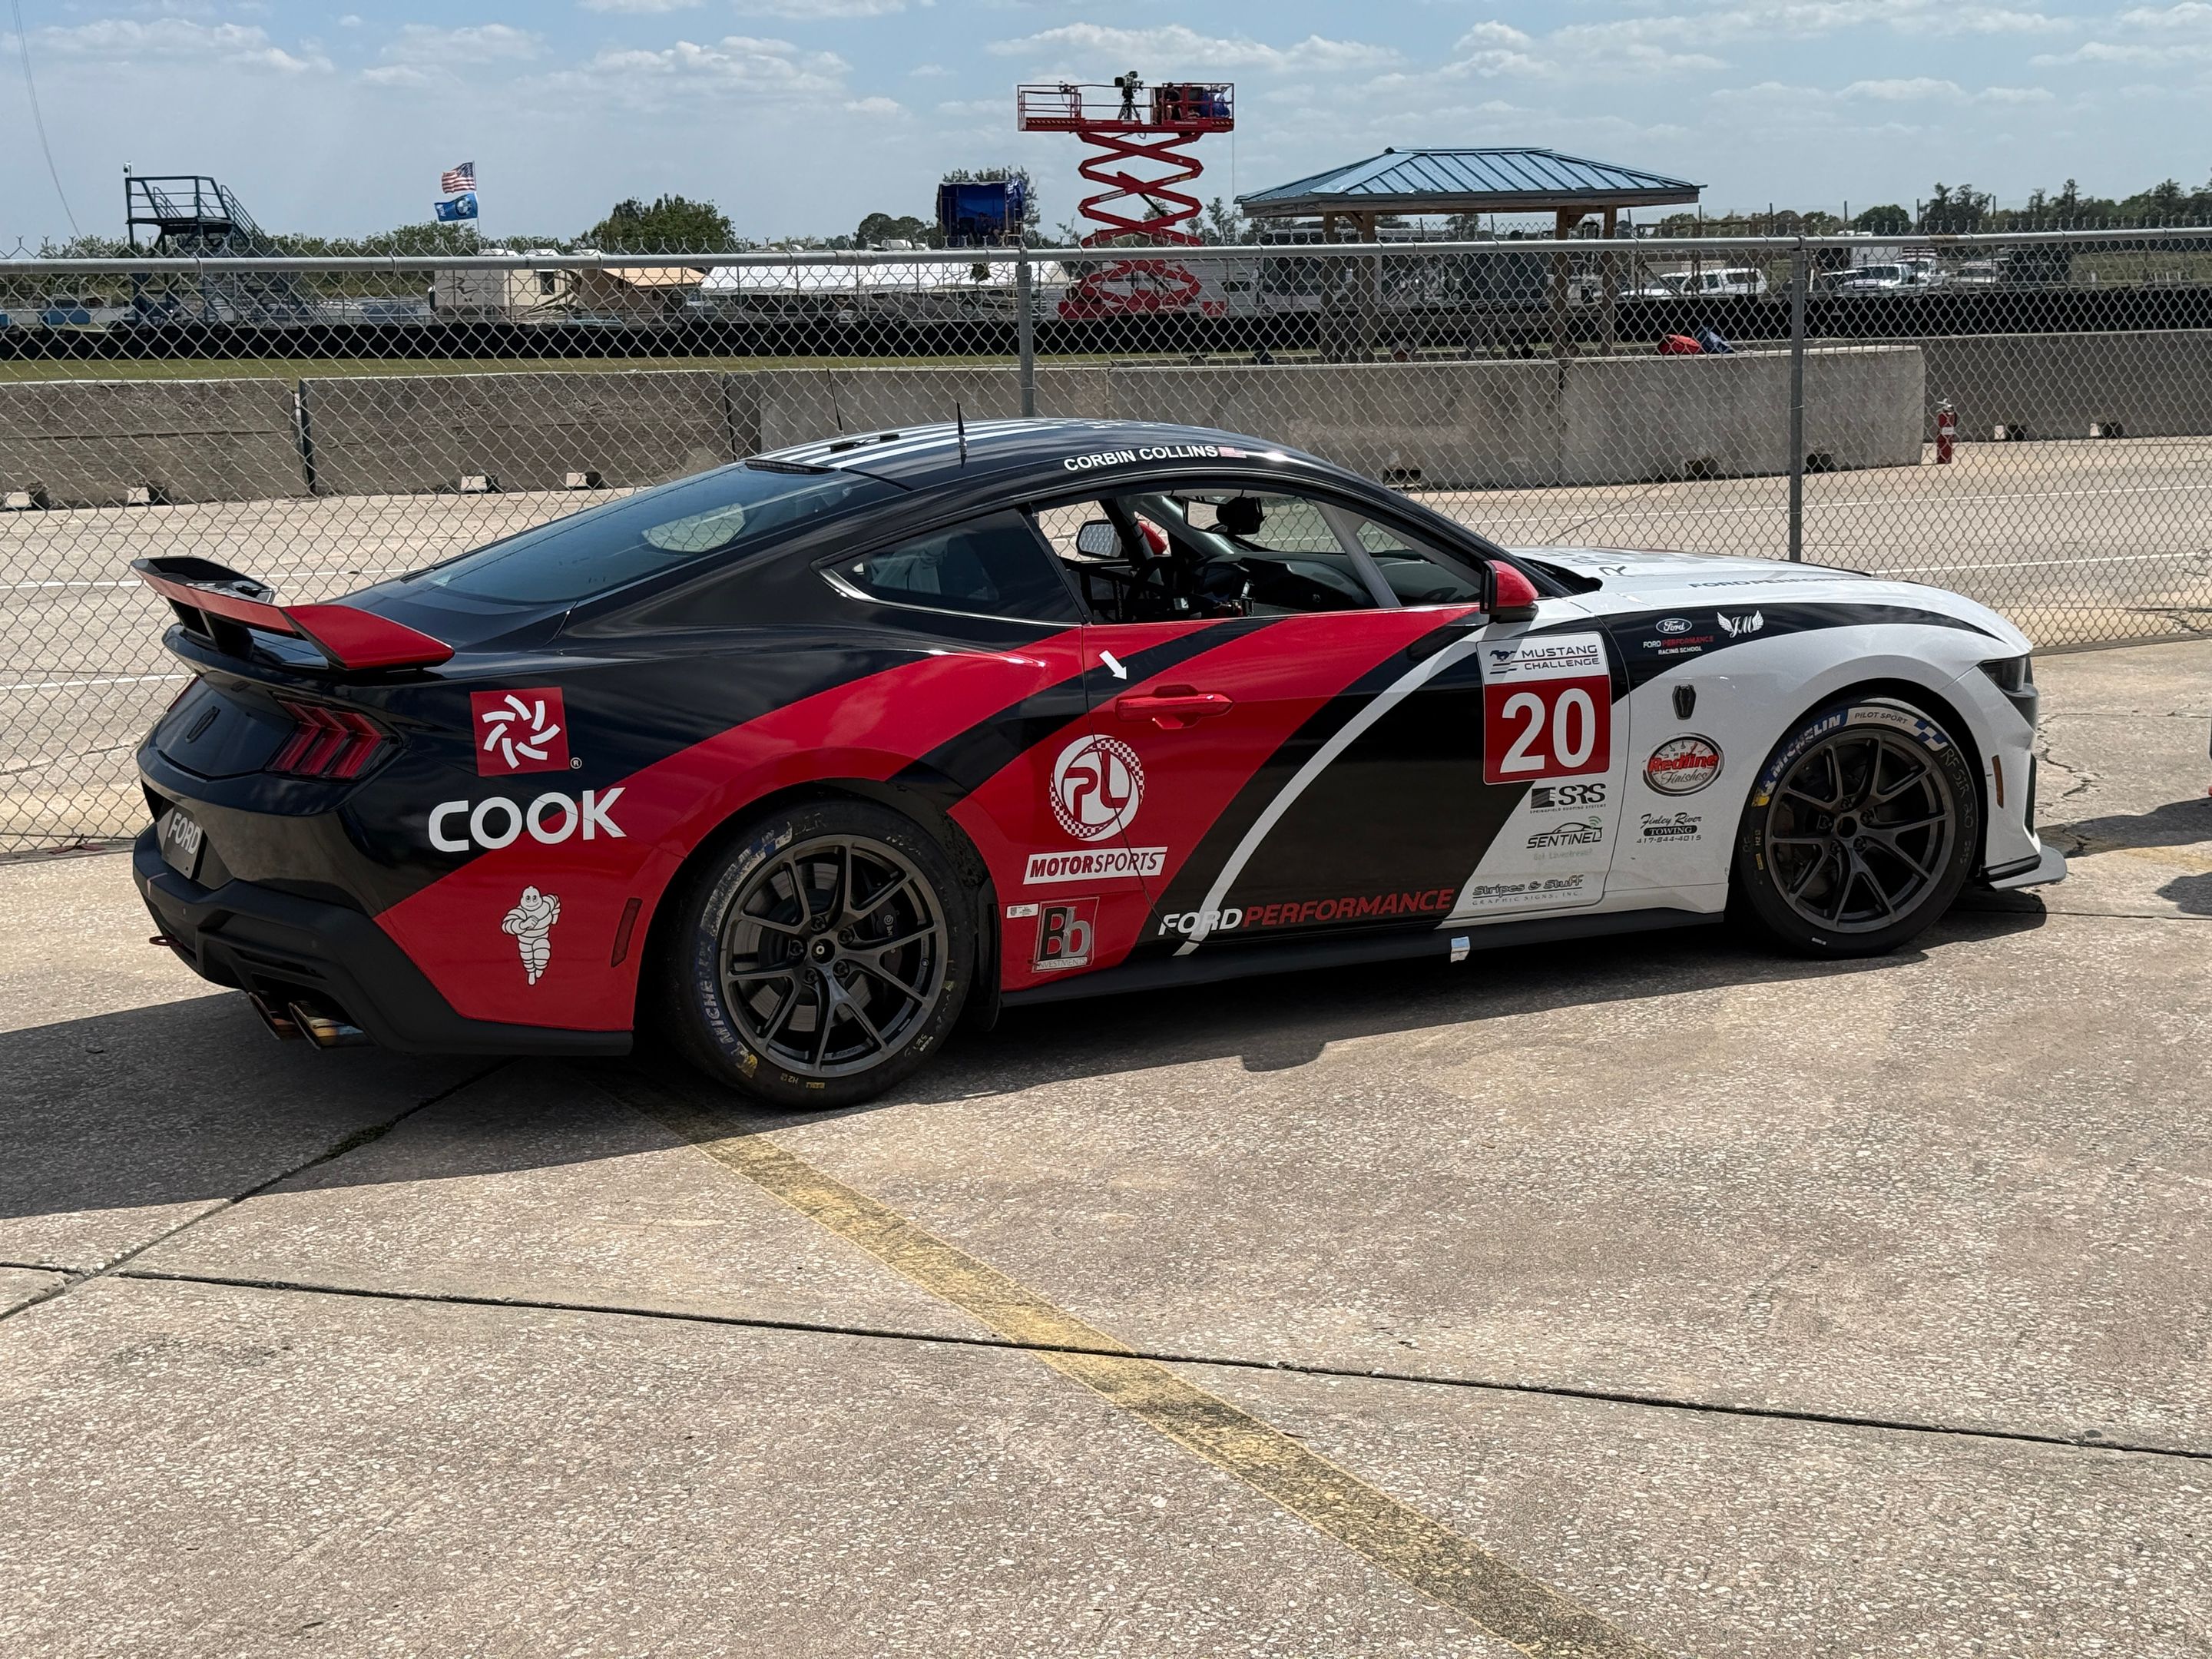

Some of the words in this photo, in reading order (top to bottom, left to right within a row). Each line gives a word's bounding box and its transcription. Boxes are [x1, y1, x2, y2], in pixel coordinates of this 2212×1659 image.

[1063, 450, 1137, 472] CORBIN
[1139, 445, 1218, 461] COLLINS
[1663, 619, 1687, 632] Ford
[1643, 640, 1661, 649] FORD
[1662, 635, 1714, 647] PERFORMANCE
[1657, 647, 1679, 655] RACING
[1680, 645, 1703, 654] SCHOOL
[1522, 644, 1598, 659] MUSTANG
[1525, 657, 1600, 670] CHALLENGE
[1854, 711, 1879, 720] PILOT
[1879, 712, 1909, 724] SPORT
[1499, 687, 1597, 774] 20
[1771, 714, 1842, 778] MICHELIN
[1647, 753, 1720, 773] Redline
[1661, 768, 1709, 785] Finishes
[1558, 783, 1607, 806] SRS
[428, 786, 628, 853] COOK
[1640, 813, 1672, 830] Finley
[1674, 812, 1702, 826] River
[167, 812, 201, 855] FORD
[1649, 826, 1692, 836] TOWING
[1526, 832, 1602, 849] SENTINEL
[1029, 852, 1158, 878] MOTORSPORTS
[1472, 883, 1525, 898] Stripes
[1528, 880, 1541, 891] &
[1543, 874, 1584, 889] Stuff
[1472, 897, 1520, 906] GRAPHIC
[1158, 908, 1243, 935] FORD
[1243, 889, 1455, 927] PERFORMANCE
[1037, 959, 1086, 969] NVESTMENTS
[699, 941, 734, 1044] MICHE
